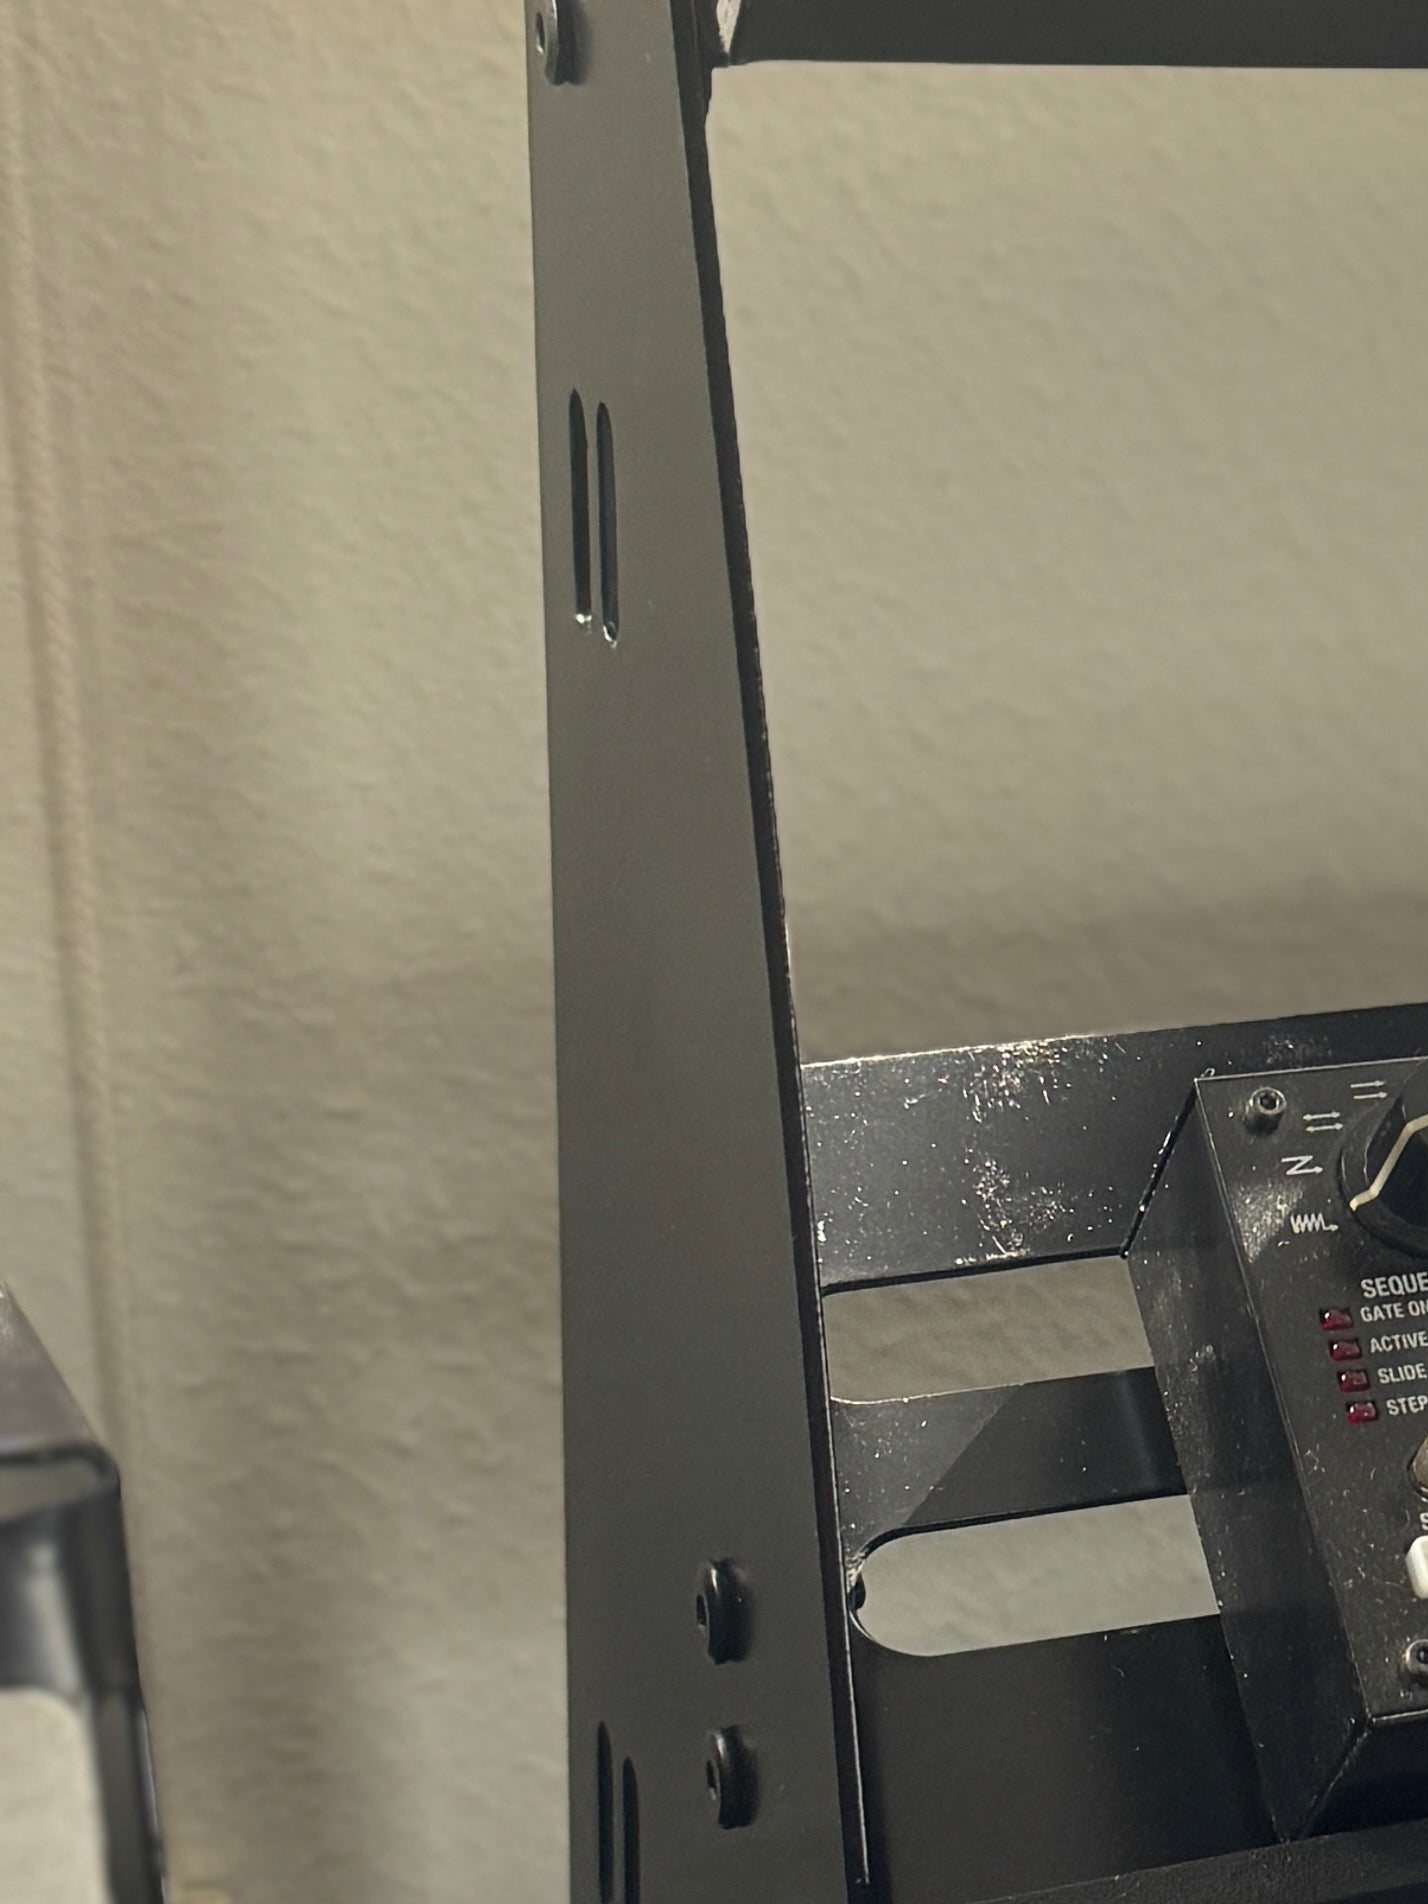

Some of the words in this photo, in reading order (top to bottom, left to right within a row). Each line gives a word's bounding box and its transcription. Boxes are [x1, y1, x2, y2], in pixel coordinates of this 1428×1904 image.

[1360, 1302, 1404, 1323] GATE
[1370, 1333, 1428, 1354] ACTIVE
[1378, 1364, 1427, 1384] SLIDE
[1386, 1396, 1428, 1416] STEP
